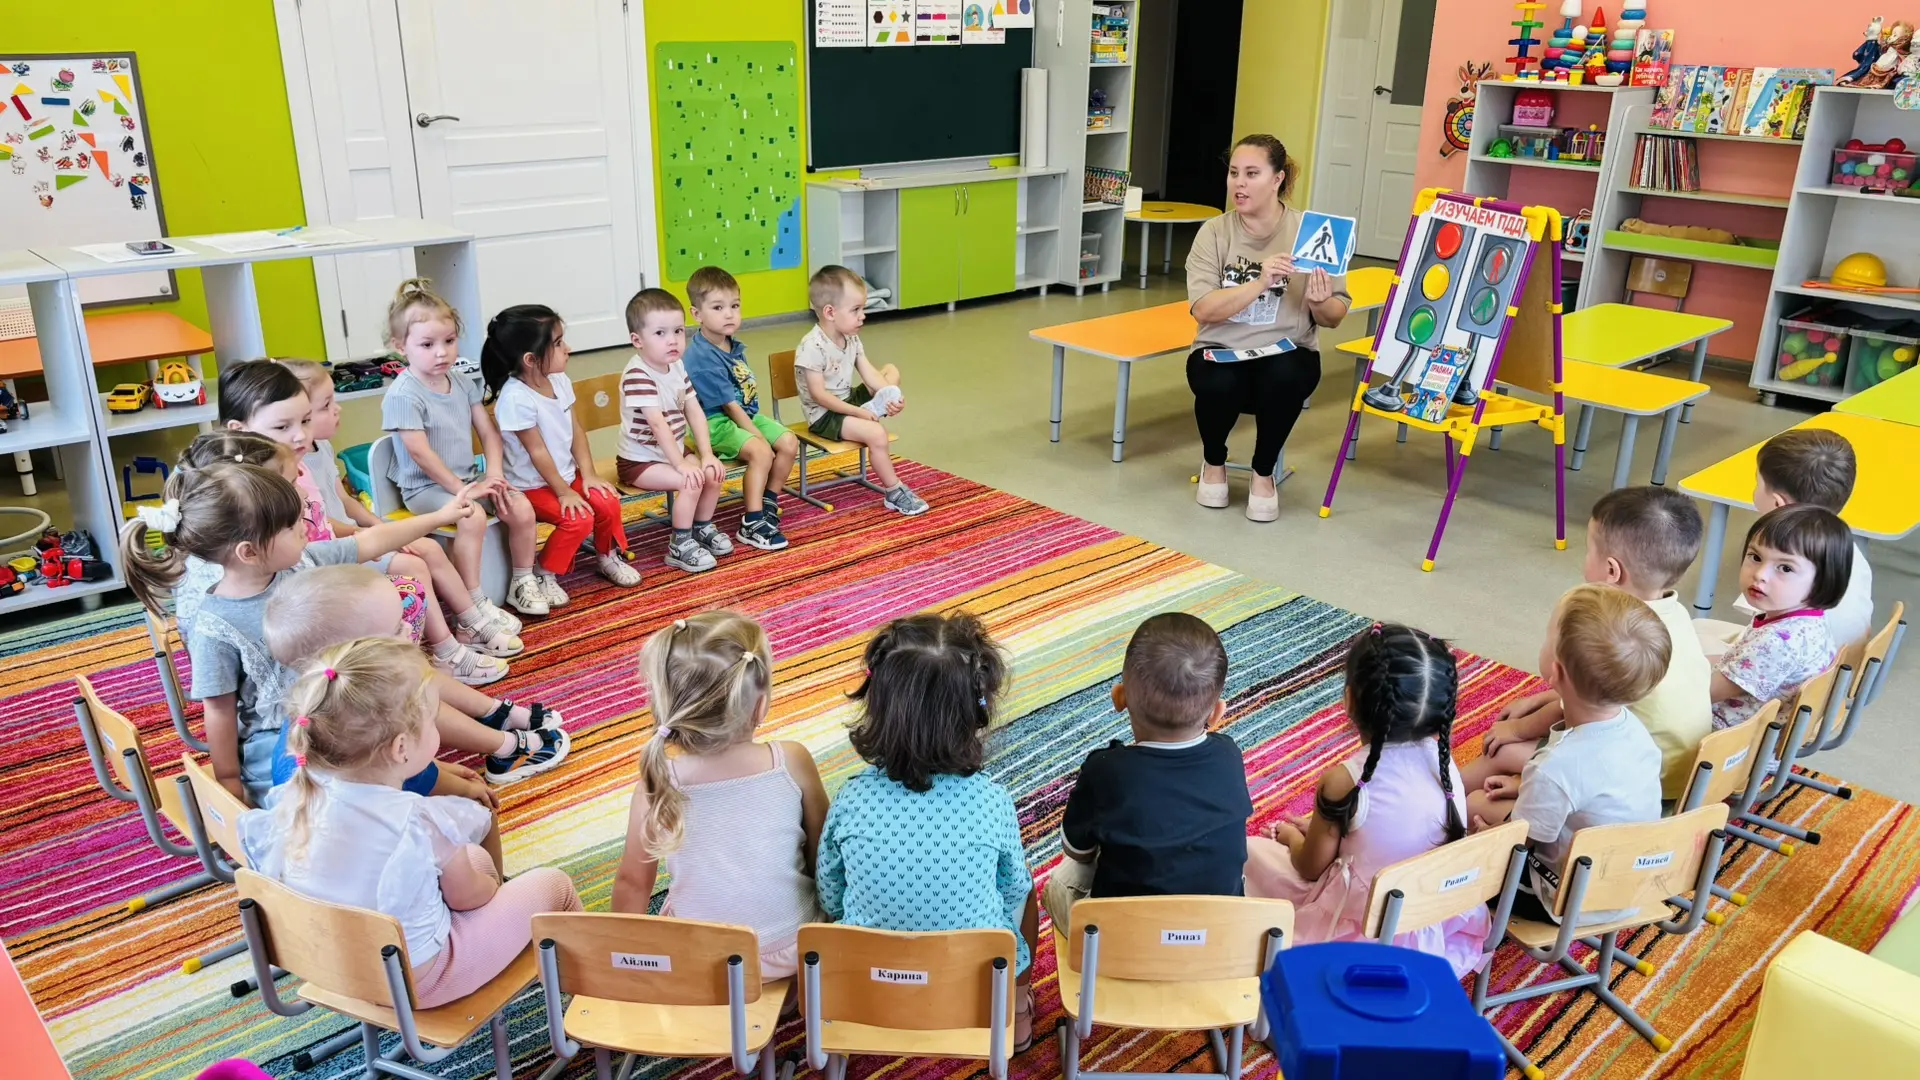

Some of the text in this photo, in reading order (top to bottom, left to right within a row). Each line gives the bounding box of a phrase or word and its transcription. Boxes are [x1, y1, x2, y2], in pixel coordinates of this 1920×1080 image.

[1434, 200, 1525, 237] ИЗУЧАЕМ ПДД
[1635, 854, 1669, 866] Матвей
[1444, 875, 1469, 888] Риана
[620, 956, 658, 967] Айлин
[878, 969, 922, 981] Карина
